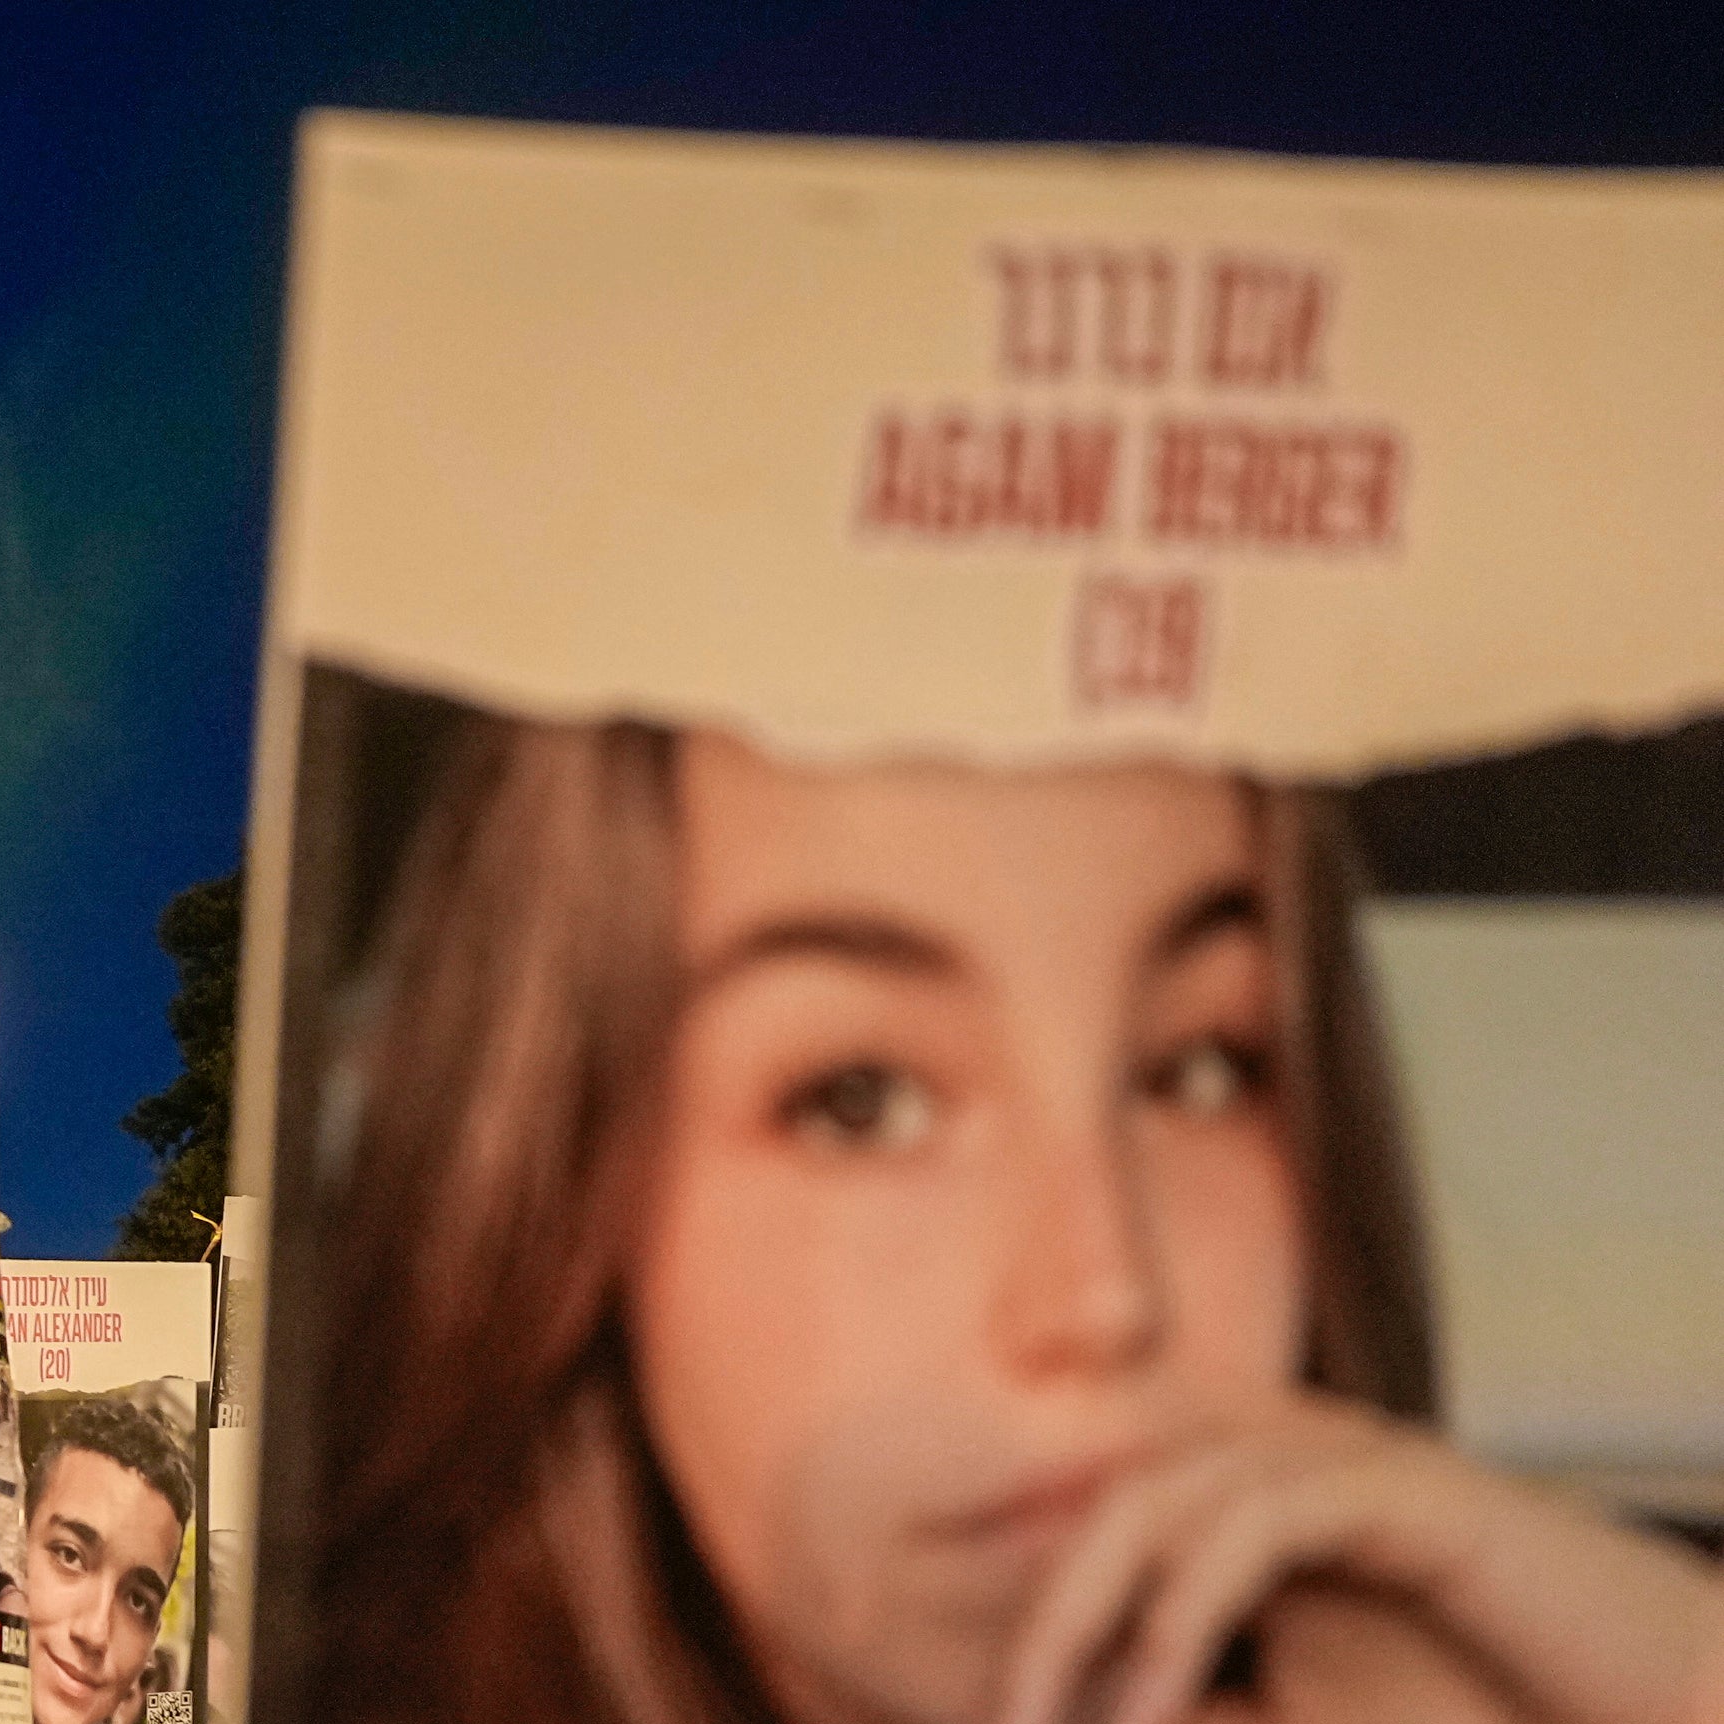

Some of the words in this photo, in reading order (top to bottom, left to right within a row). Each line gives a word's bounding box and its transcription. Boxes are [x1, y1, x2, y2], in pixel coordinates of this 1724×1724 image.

[75, 1277, 107, 1310] עידן
[7, 1313, 28, 1343] AN
[33, 1313, 122, 1343] ALEXANDER
[39, 1347, 71, 1383] (20)
